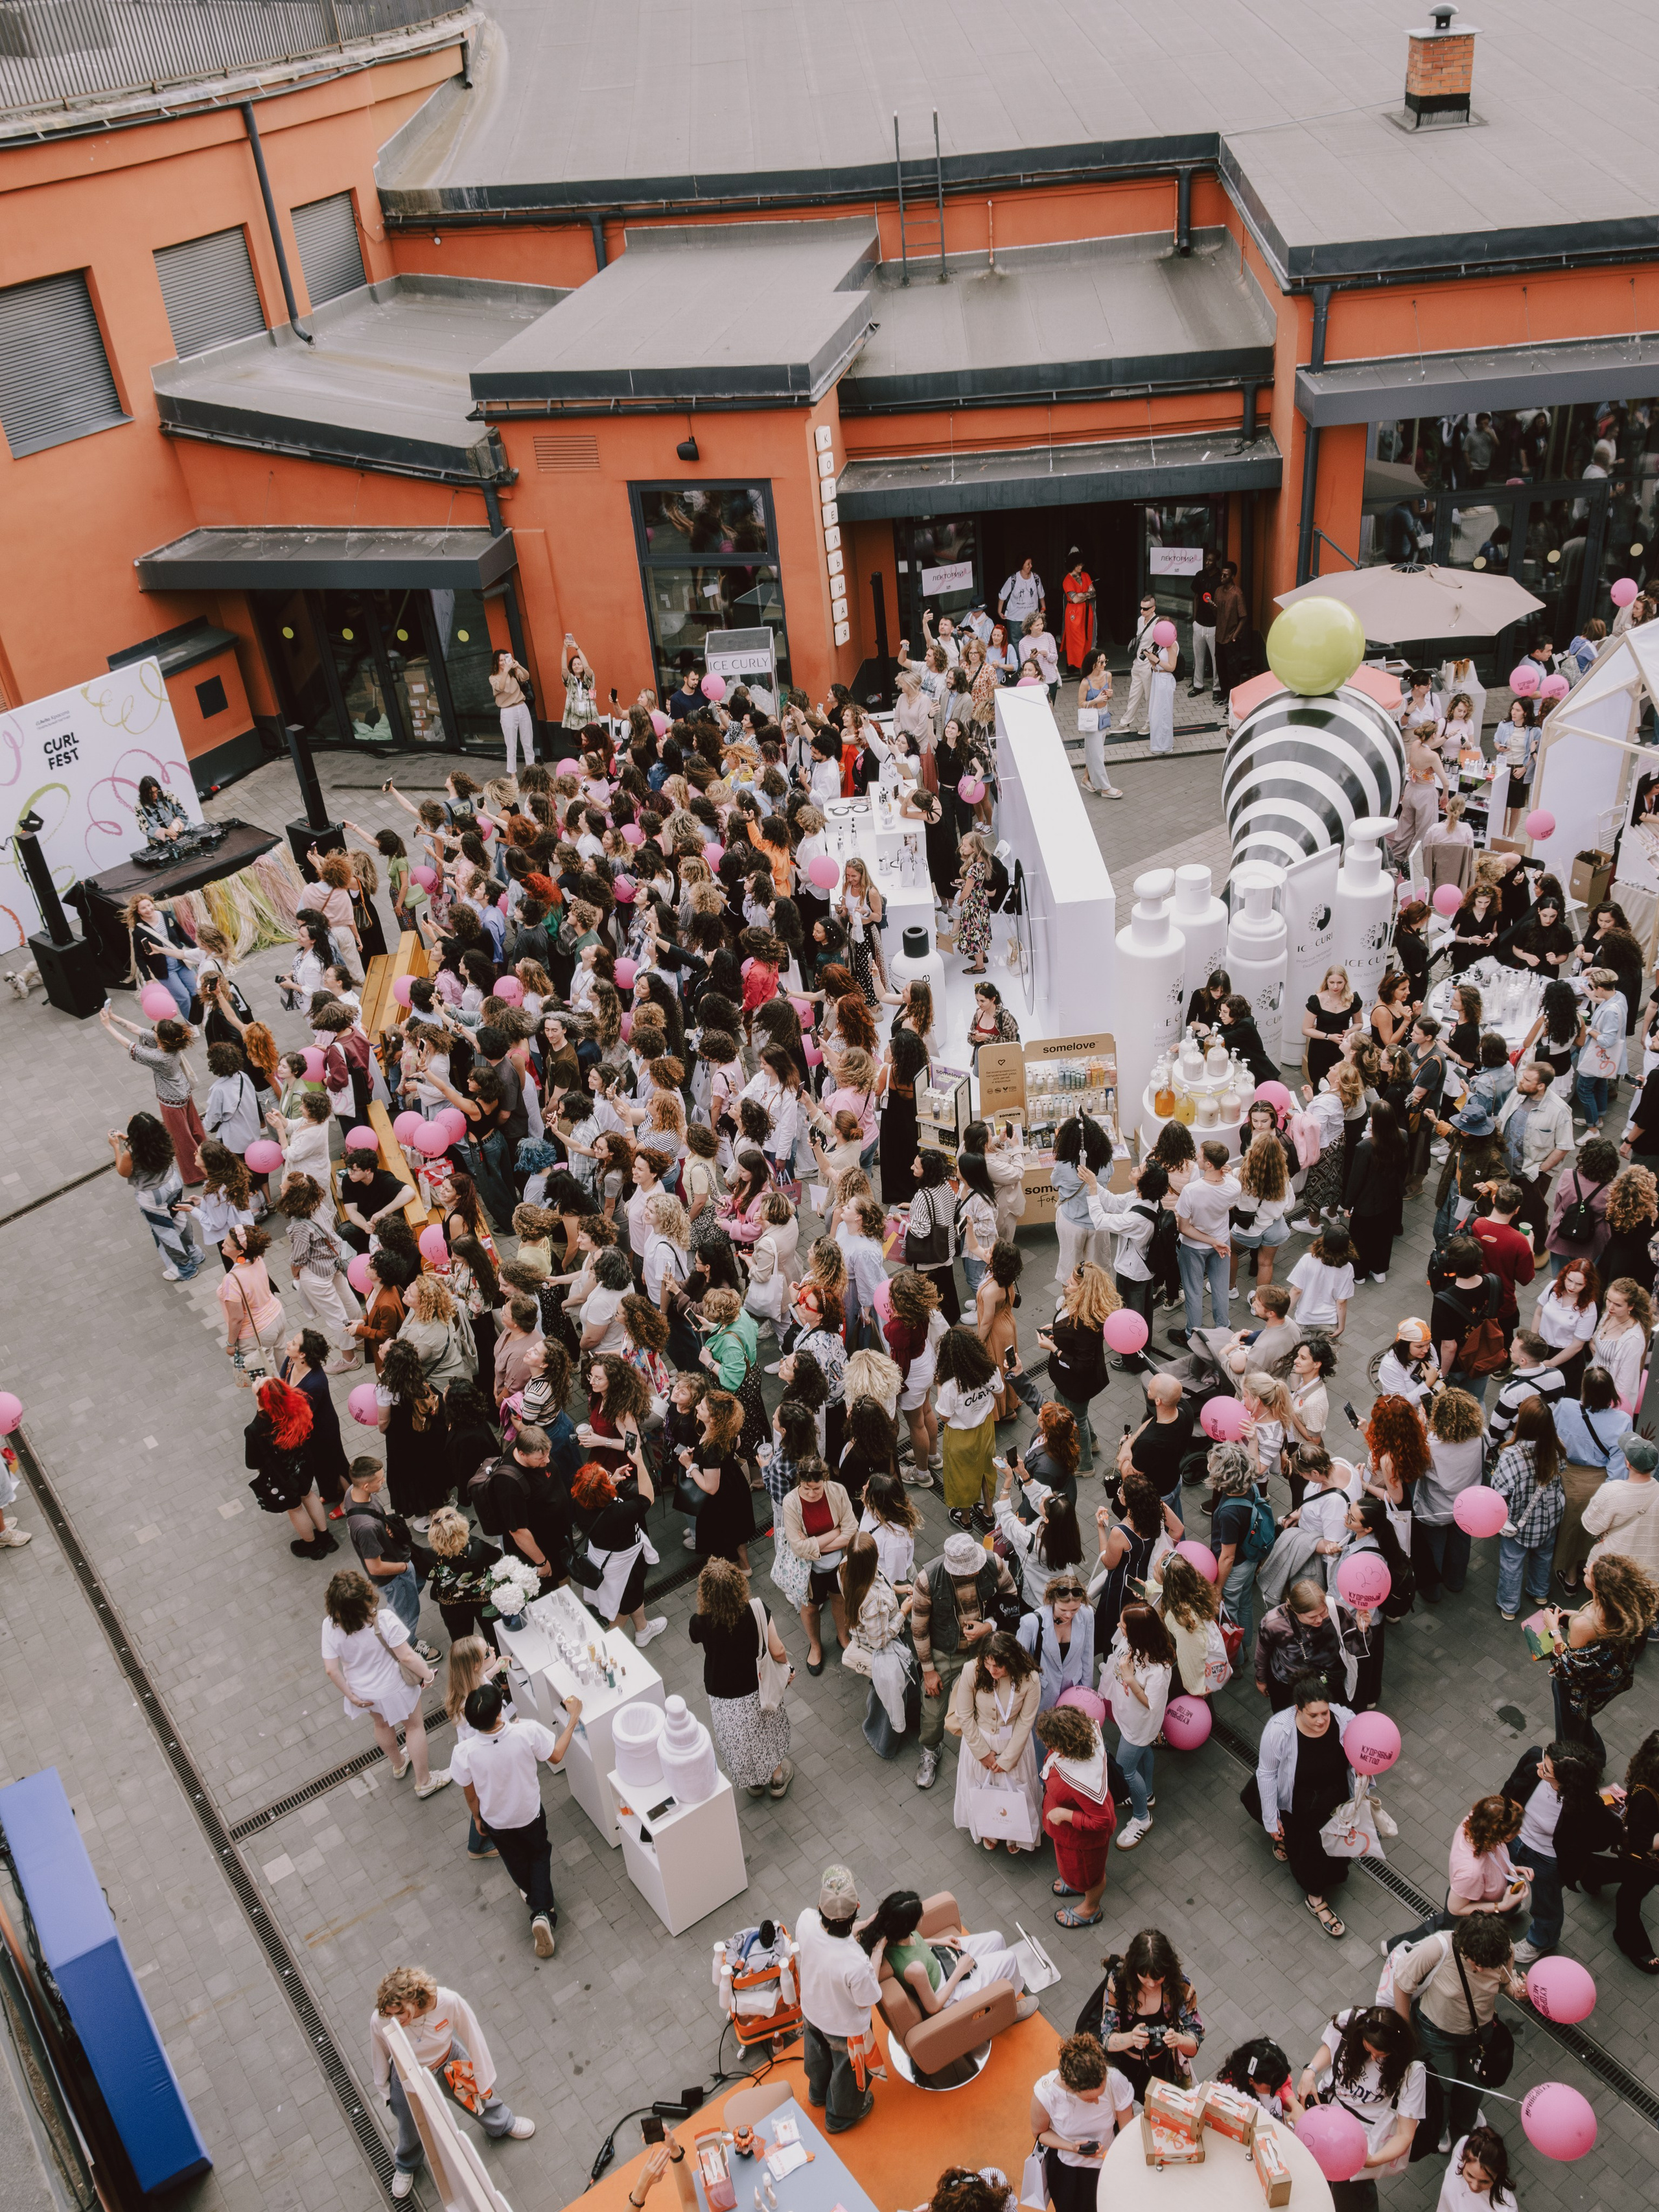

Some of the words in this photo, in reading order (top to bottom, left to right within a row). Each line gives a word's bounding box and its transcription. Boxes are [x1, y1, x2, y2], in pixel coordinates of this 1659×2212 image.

[823, 434, 847, 638] КОТЕЛЬНАЯ
[932, 570, 964, 581] ЛЕКТОРИЙ
[709, 660, 728, 671] ICE
[731, 657, 769, 669] CURLY
[43, 731, 80, 754] CURL
[48, 747, 79, 771] FEST
[1345, 959, 1364, 968] ICE
[1042, 1040, 1096, 1054] somelove
[936, 1069, 964, 1080] somelove
[1037, 1193, 1058, 1207] FOR
[1349, 1590, 1382, 1603] КУДРЯВЫЙ
[1349, 1598, 1369, 1607] МЕТОД
[1165, 1708, 1190, 1725] КУДРЯВЫЙ
[1176, 1705, 1194, 1718] МЕТОД
[1359, 1752, 1380, 1765] МЕТОД
[1361, 1745, 1393, 1762] КУДРЯВЫЙ
[1532, 1983, 1541, 2009] МЕТОД
